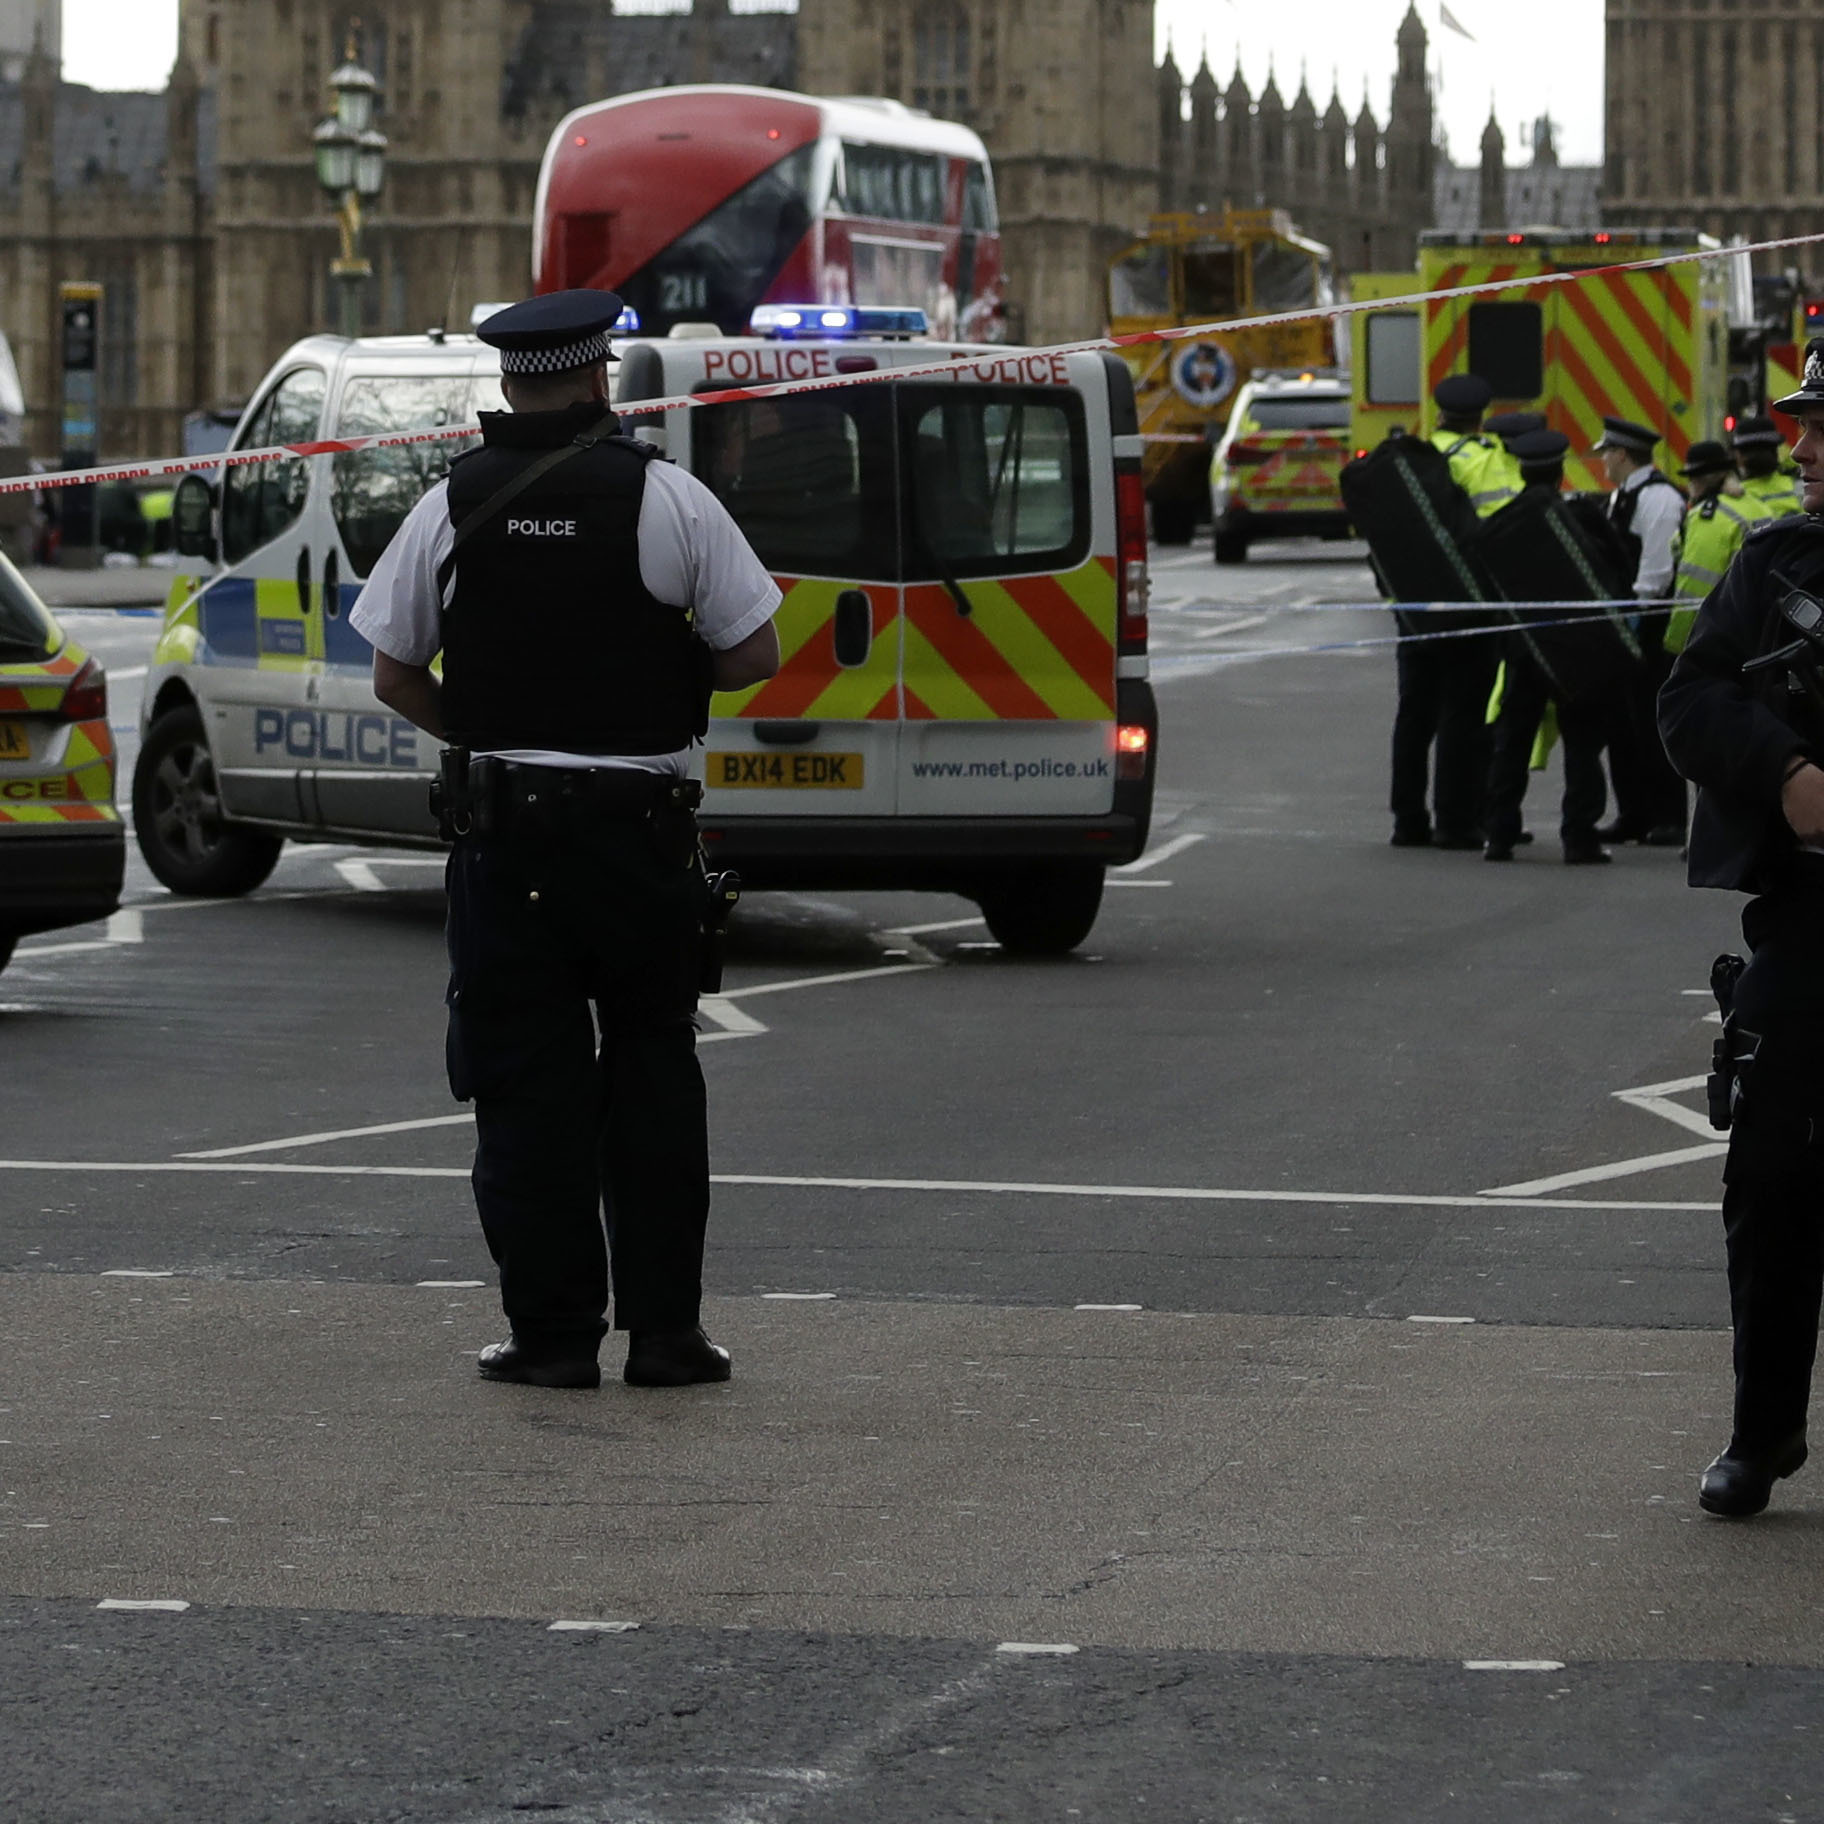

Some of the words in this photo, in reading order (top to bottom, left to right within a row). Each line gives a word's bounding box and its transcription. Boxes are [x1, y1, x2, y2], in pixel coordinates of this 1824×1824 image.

[662, 276, 707, 310] 211
[704, 349, 831, 380] POLICE
[507, 519, 577, 536] POLICE
[256, 708, 418, 767] POLICE
[723, 756, 782, 784] BX14
[793, 756, 847, 784] EDK
[911, 758, 1109, 782] www.met.police.uk
